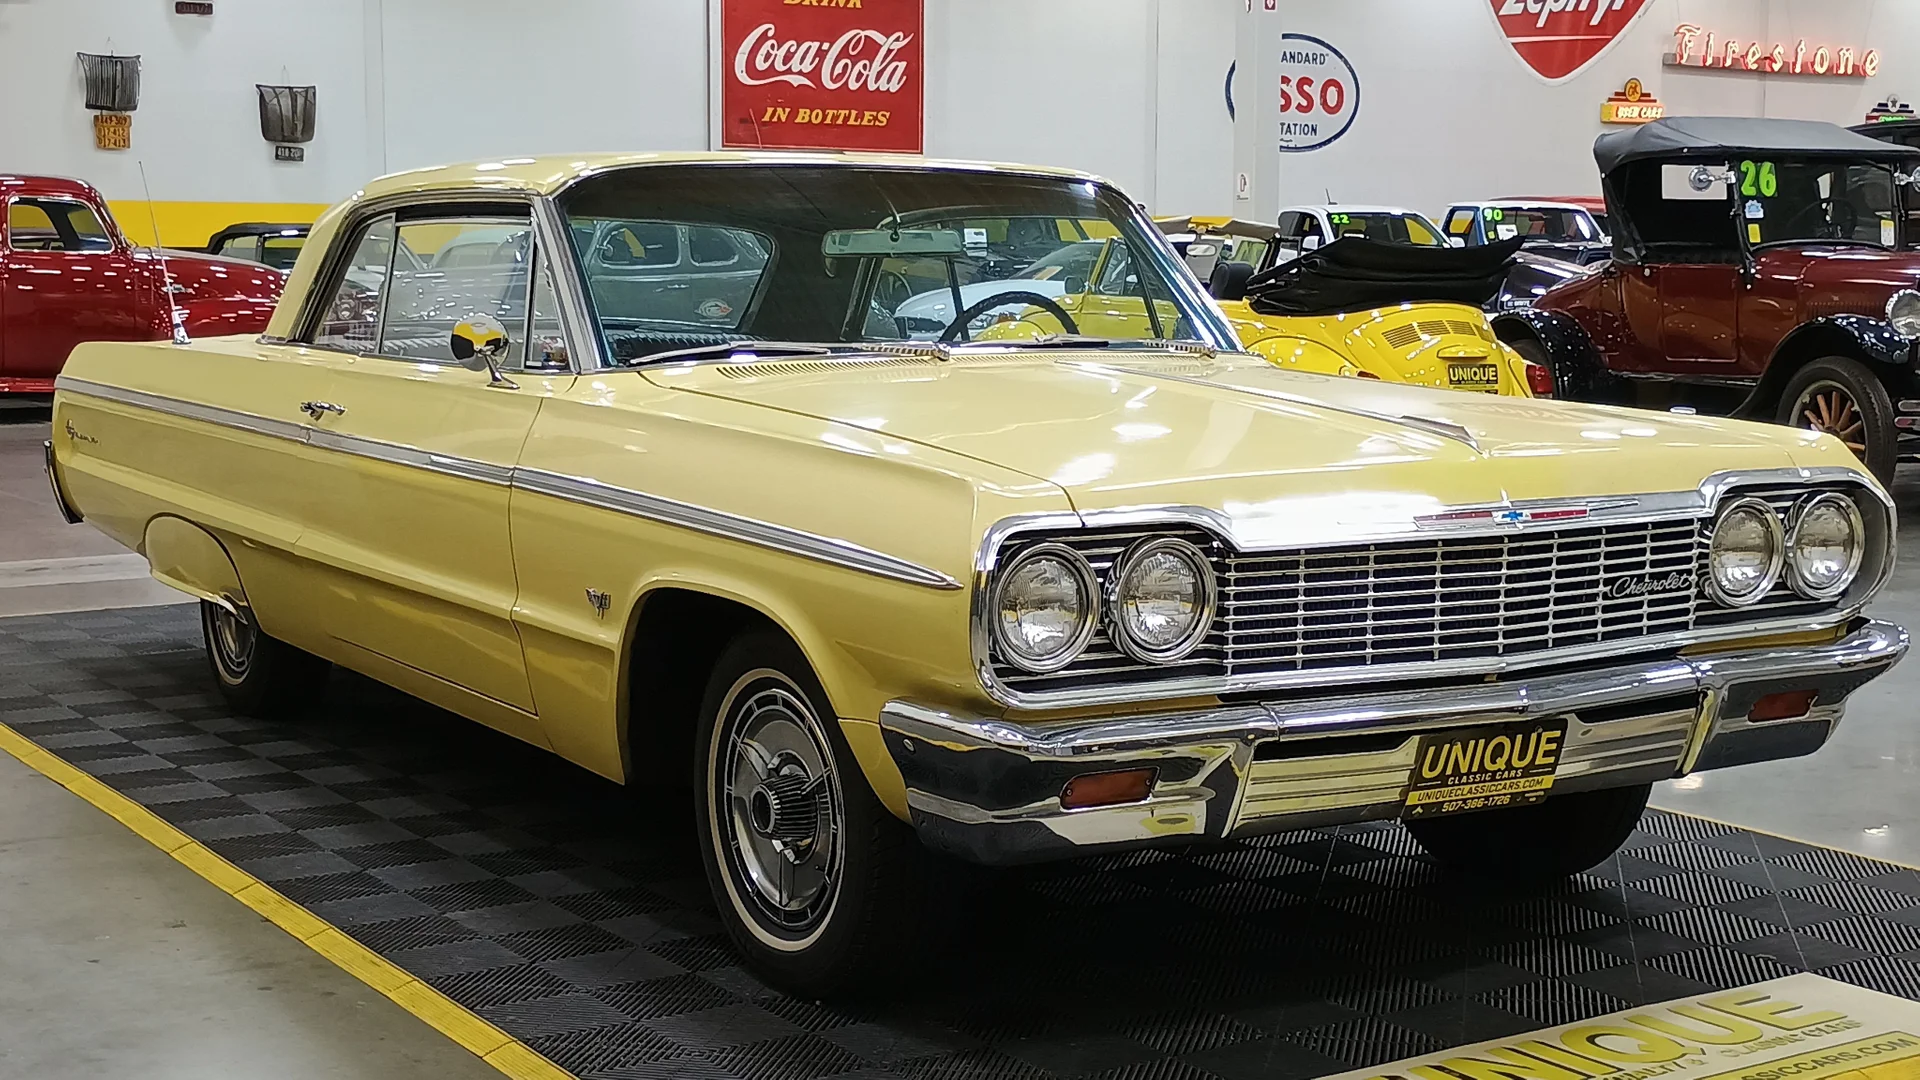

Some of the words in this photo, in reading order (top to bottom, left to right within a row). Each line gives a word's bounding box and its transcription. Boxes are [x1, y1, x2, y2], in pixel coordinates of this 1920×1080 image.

[734, 23, 915, 93] Coca-Cola
[1280, 50, 1330, 66] ANDARD"
[1674, 23, 1880, 77] Firestone
[1280, 74, 1345, 116] SSO
[761, 106, 791, 123] IN
[794, 108, 891, 127] BOTTLES
[1279, 121, 1318, 136] TATION
[1740, 159, 1777, 197] 26
[1330, 214, 1350, 224] 22
[1483, 208, 1503, 221] 90
[1449, 366, 1498, 381] UNIQUE
[1612, 571, 1691, 598] Chevrolet
[1421, 729, 1562, 779] UNIQUE
[1416, 777, 1545, 802] UNIQUECLASSICCARS.COM
[1447, 772, 1493, 786] CLASSIC
[1495, 768, 1524, 780] CARS
[1358, 990, 1849, 1080] NIQUE
